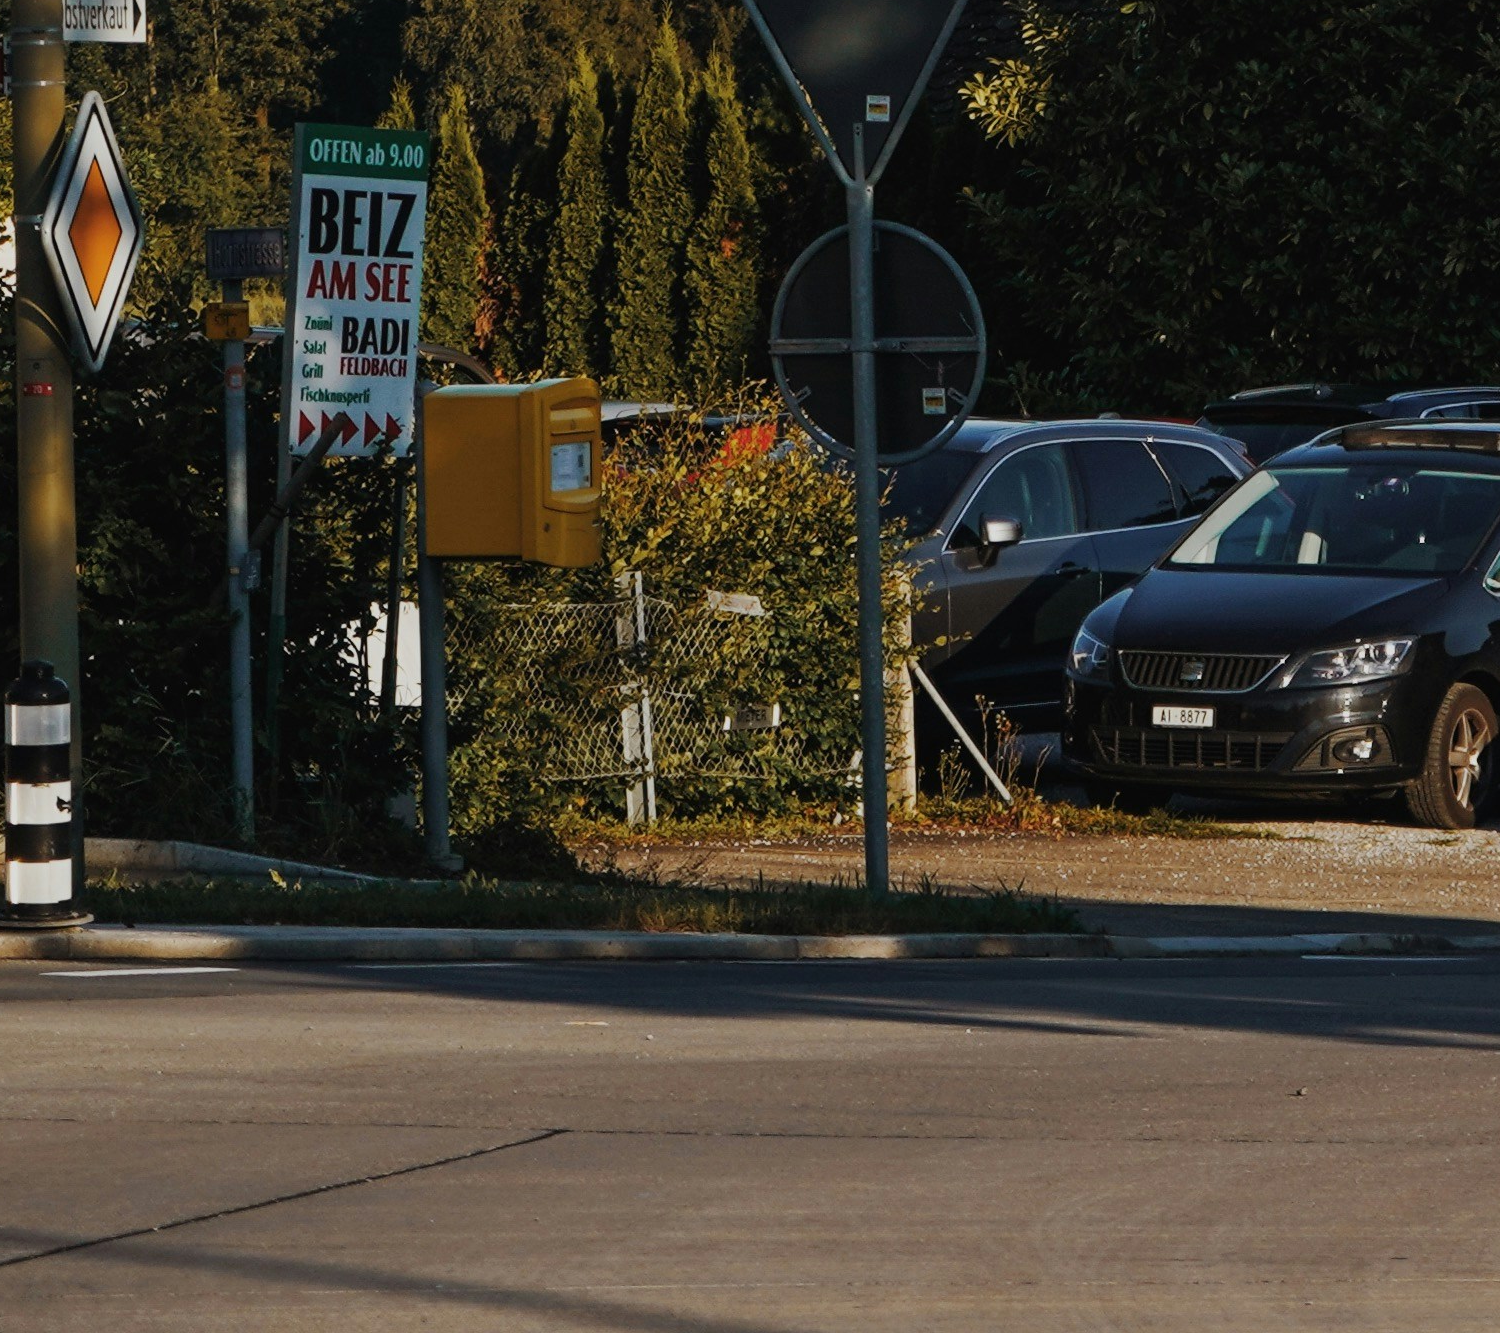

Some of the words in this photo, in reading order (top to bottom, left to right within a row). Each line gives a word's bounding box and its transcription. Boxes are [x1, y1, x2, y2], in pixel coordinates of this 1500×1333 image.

[309, 138, 362, 165] OFFEN
[365, 142, 385, 166] ab
[389, 143, 424, 169] 9.00
[308, 187, 417, 259] BEIZ
[306, 259, 357, 300] AM
[364, 261, 414, 303] SEE
[302, 339, 327, 355] Salat
[340, 316, 410, 356] BADI
[301, 362, 324, 379] Grill
[340, 356, 407, 378] FELDBACH
[300, 385, 371, 407] Fischknusperli
